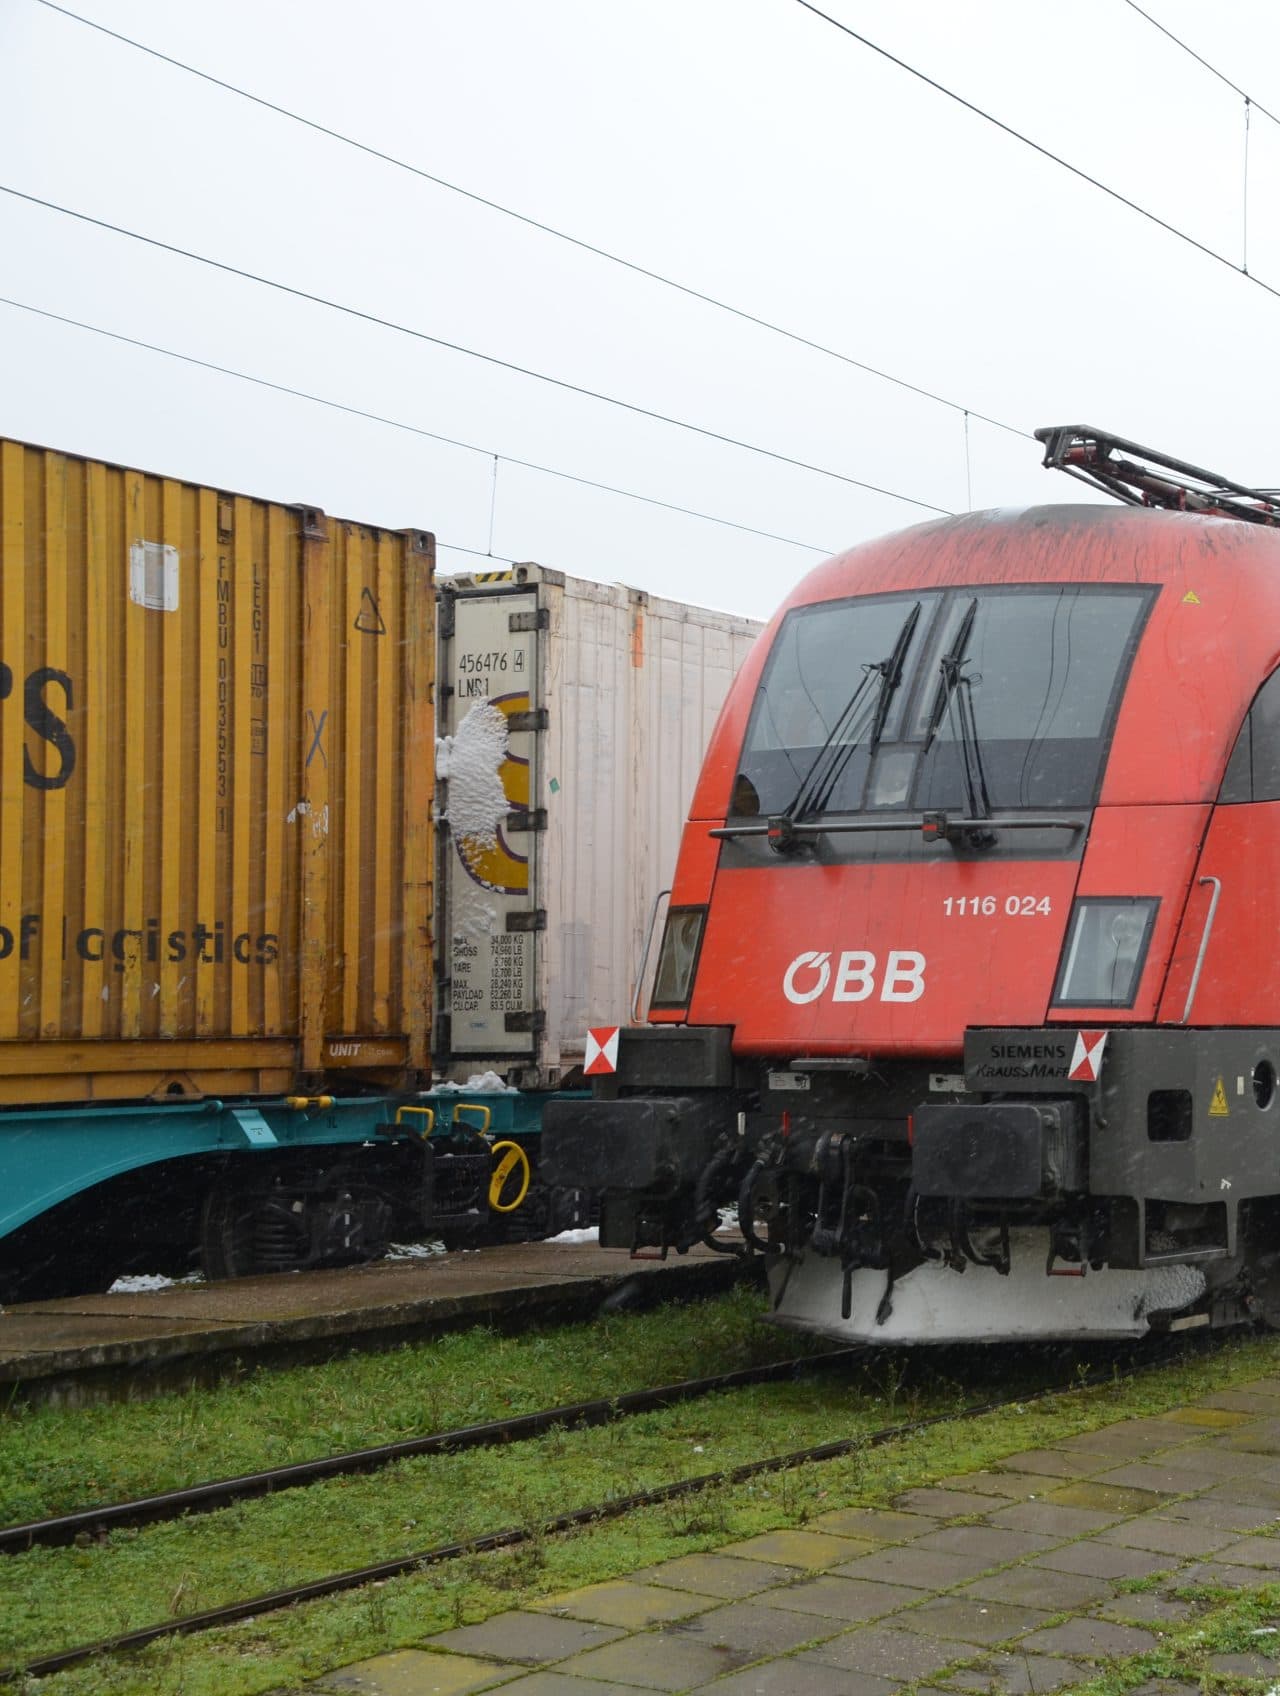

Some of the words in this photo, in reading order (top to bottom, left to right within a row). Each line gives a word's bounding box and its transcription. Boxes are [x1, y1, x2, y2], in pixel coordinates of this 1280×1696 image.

[217, 556, 229, 648] FMBU
[459, 652, 507, 673] 456476
[515, 651, 523, 670] 4
[943, 896, 996, 916] 1116
[1004, 895, 1051, 916] 024
[513, 934, 524, 944] KG
[513, 945, 522, 955] LB
[513, 957, 523, 966] KG
[453, 963, 471, 973] TARE
[513, 967, 522, 977] LB
[783, 950, 927, 1005] ÖBB
[513, 979, 523, 988] KG
[453, 990, 484, 1000] PAYLOAD
[513, 989, 522, 999] LB
[991, 1045, 1066, 1058] SIEMENS
